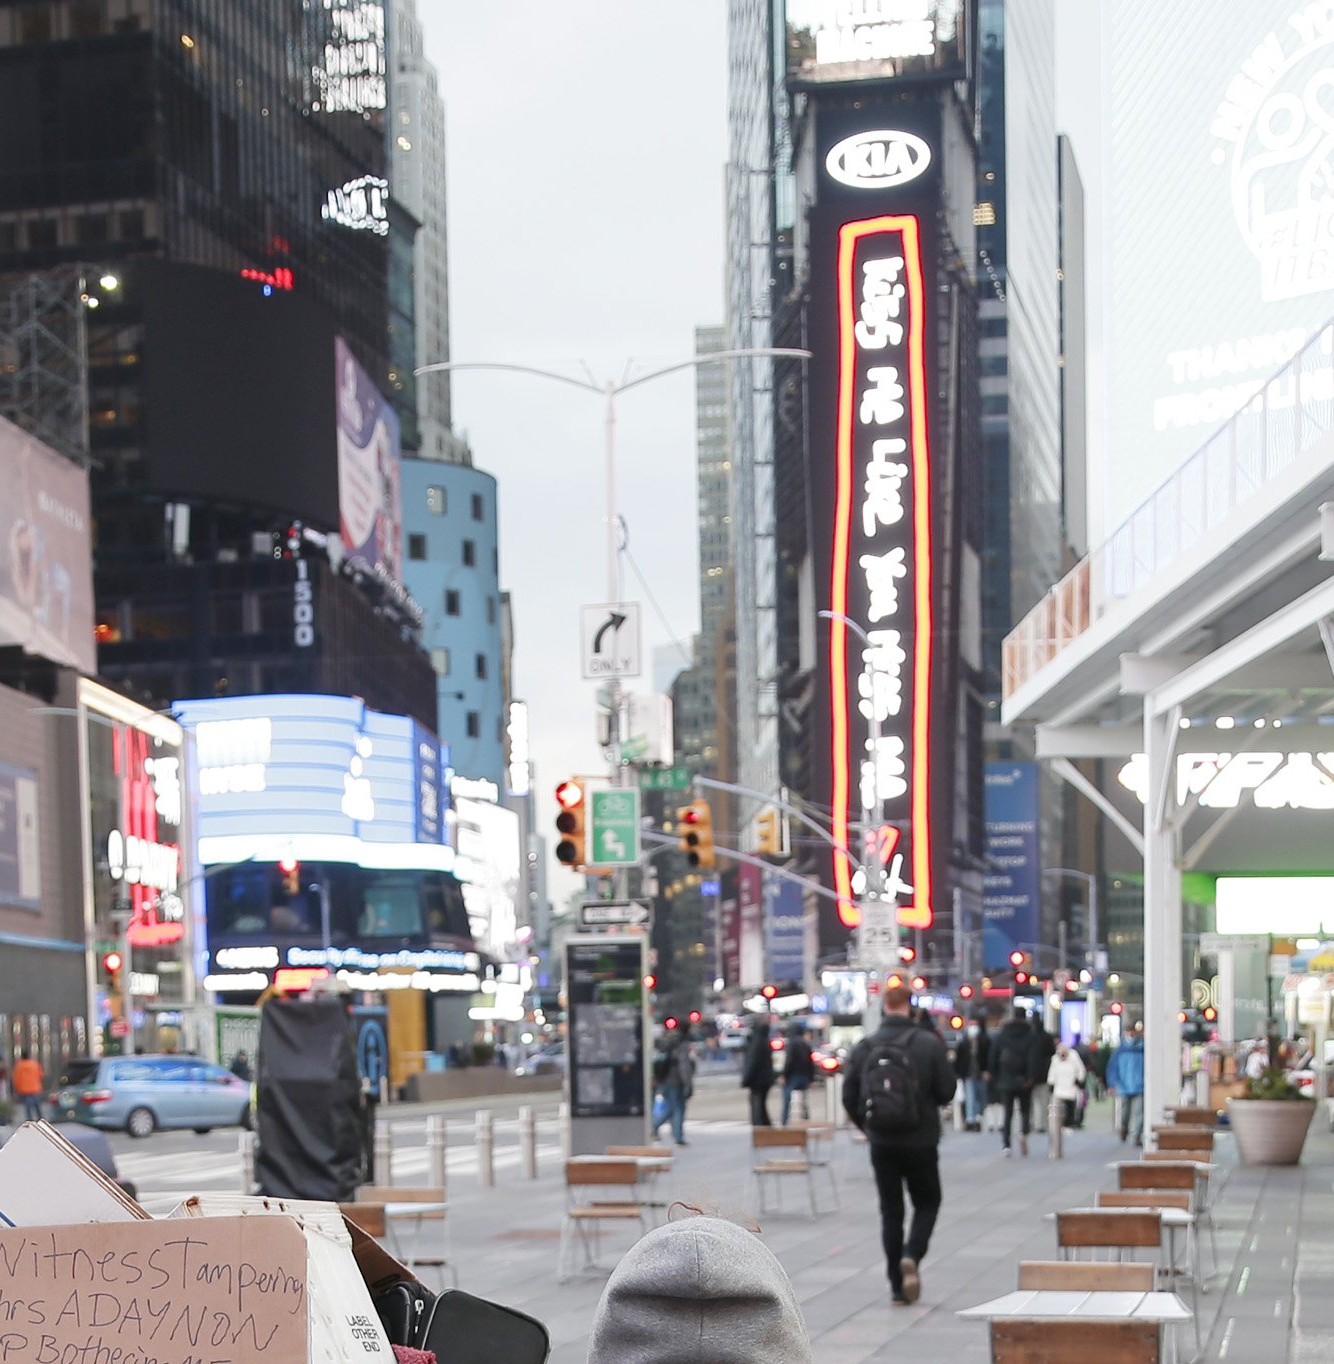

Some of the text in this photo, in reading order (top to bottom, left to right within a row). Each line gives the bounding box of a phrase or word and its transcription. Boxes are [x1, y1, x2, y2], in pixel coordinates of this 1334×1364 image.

[293, 559, 314, 646] 1500
[589, 658, 632, 673] ONLY
[345, 1315, 373, 1327] LABEL
[352, 1328, 379, 1340] OTHER
[362, 1341, 381, 1352] END
